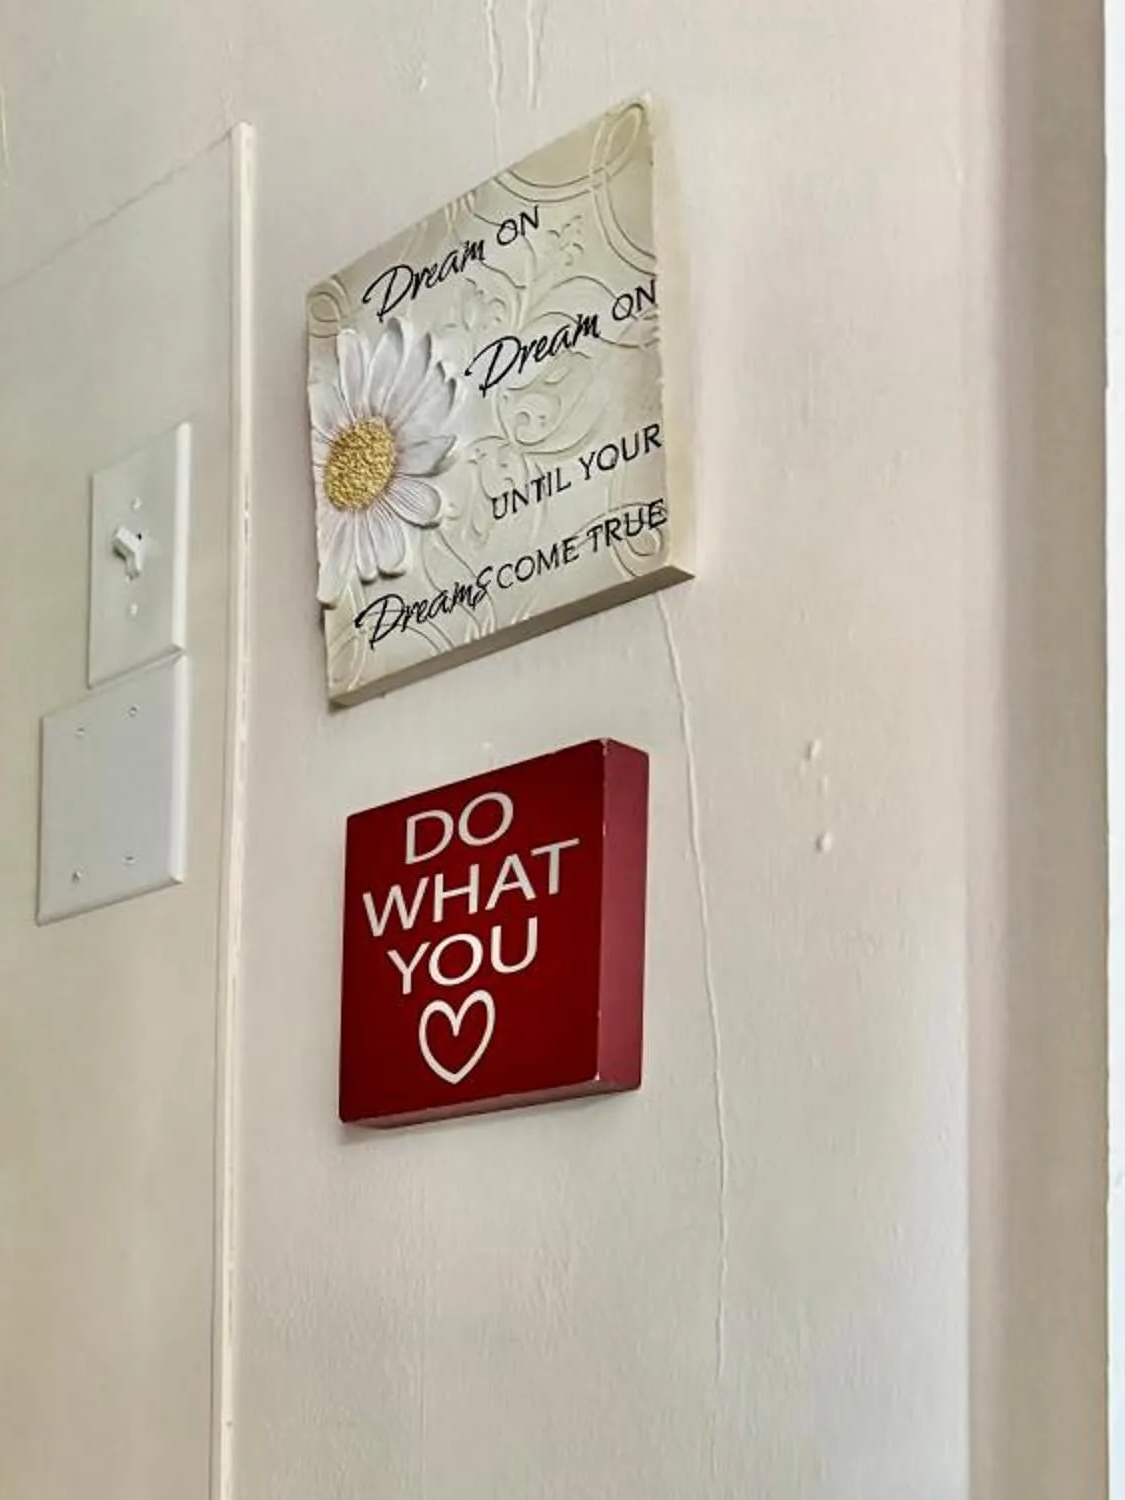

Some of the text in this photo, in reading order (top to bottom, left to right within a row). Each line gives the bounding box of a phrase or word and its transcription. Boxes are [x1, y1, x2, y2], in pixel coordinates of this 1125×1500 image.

[362, 205, 540, 321] Dream ON
[464, 279, 657, 397] Dream ON
[490, 422, 662, 521] UNTIL YOUR
[354, 498, 669, 650] Dreams COME TRUE
[405, 791, 514, 865] DO
[362, 838, 580, 937] WHAT
[387, 916, 538, 995] YOU
